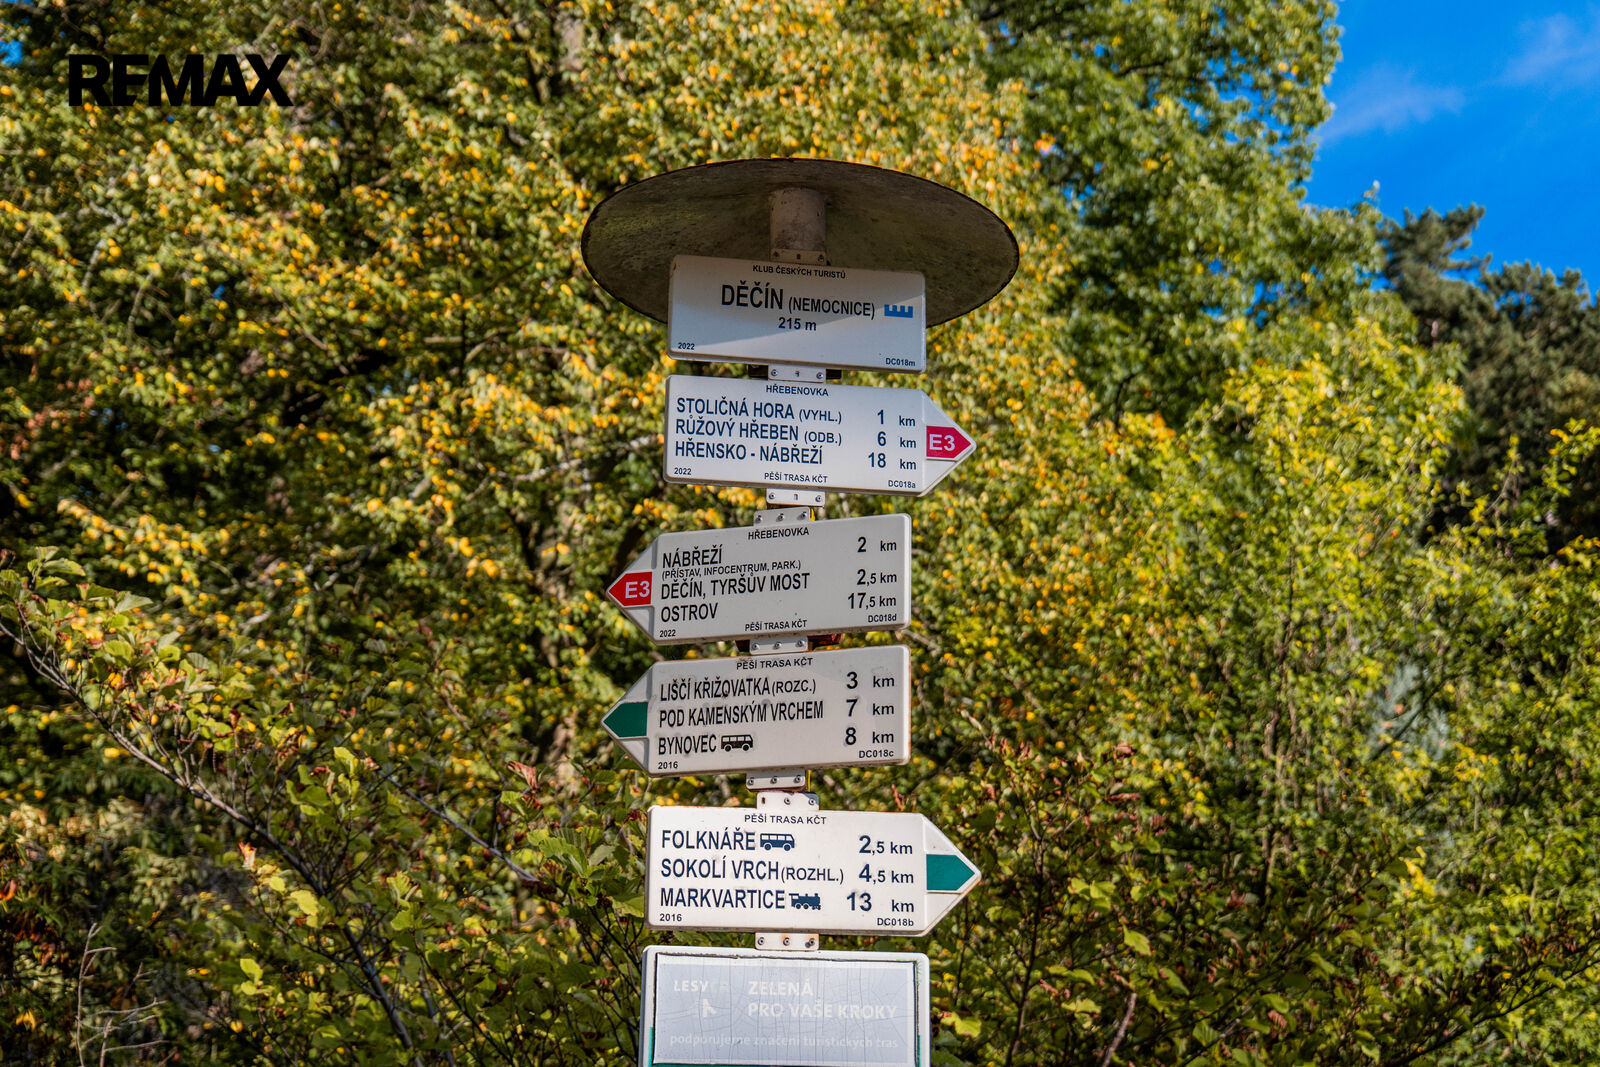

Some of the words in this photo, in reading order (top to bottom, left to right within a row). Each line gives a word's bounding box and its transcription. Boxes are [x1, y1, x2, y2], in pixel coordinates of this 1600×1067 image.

[753, 265, 773, 274] KLUB
[776, 266, 811, 276] ČESKÝCH
[814, 269, 846, 279] TURISTŮ
[722, 280, 783, 310] DĚČÍN
[789, 296, 875, 320] (NEMOCNICE)
[778, 317, 801, 330] 215
[805, 320, 817, 331] m
[678, 342, 695, 350] 2022
[886, 358, 916, 366] DC018m
[766, 384, 828, 397] HŘEBENOVKA
[676, 396, 749, 417] STOLIČNÁ
[753, 402, 795, 419] HORA
[799, 409, 842, 424] (VYHL.)
[877, 409, 884, 424] 1
[899, 415, 916, 427] km
[676, 414, 735, 436] RŮŽOVÝ
[740, 421, 799, 441] HŘEBEN
[804, 431, 842, 445] (ODB.)
[877, 432, 886, 446] 6
[899, 437, 917, 449] km
[929, 434, 955, 451] E3
[675, 438, 746, 460] HŘENSKO
[760, 445, 823, 465] NÁBŘEŽÍ
[868, 452, 886, 469] 18
[900, 459, 917, 470] km
[674, 467, 692, 476] 2022
[764, 472, 782, 481] PĚŠÍ
[784, 474, 810, 482] TRASA
[811, 474, 827, 483] KČT
[888, 479, 916, 489] DC018a
[748, 526, 809, 540] HŘEBENOVKA
[662, 544, 722, 568] NÁBŘEŽÍ
[858, 536, 866, 552] 2
[880, 540, 896, 552] km
[662, 567, 702, 580] (PŘÍSTAV,
[704, 562, 769, 576] INFOCENTRUM,
[772, 560, 801, 571] PARK.)
[625, 580, 650, 598] E3
[661, 578, 706, 600] DĚČÍN,
[711, 572, 766, 596] TYRŠŮV
[770, 573, 810, 591] MOST
[857, 569, 876, 586] 2,5
[880, 573, 897, 584] km
[661, 602, 718, 622] OSTROV
[848, 592, 876, 610] 17,5
[879, 596, 896, 607] km
[745, 622, 762, 631] PĚŠÍ
[764, 621, 789, 630] TRASA
[791, 618, 807, 628] KČT
[868, 614, 897, 623] DC018d
[660, 629, 676, 638] 2022
[736, 659, 758, 670] PĚŠÍ
[760, 659, 792, 668] TRASA
[794, 656, 813, 666] KČT
[660, 680, 691, 702] LIŠČÍ
[846, 671, 858, 689] 3
[872, 675, 895, 688] km
[659, 708, 684, 728] POD
[688, 700, 767, 726] KAMENSKÝM
[771, 700, 823, 720] VRCHEM
[846, 698, 858, 717] 7
[872, 703, 895, 716] km
[658, 734, 717, 756] BYNOVEC
[845, 726, 857, 745] 8
[872, 731, 894, 744] km
[859, 750, 894, 758] DC018c
[658, 761, 678, 770] 2016
[744, 813, 767, 823] PĚŠÍ
[770, 815, 803, 824] TRASA
[806, 815, 826, 825] KČT
[661, 827, 756, 851] FOLKNÁŘE
[859, 835, 885, 855] 2,5
[890, 841, 913, 854] km
[661, 856, 727, 879] SOKOLÍ
[859, 864, 886, 884] 4,5
[891, 870, 914, 883] km
[660, 887, 785, 909] MARKVARTICE
[847, 892, 872, 912] 13
[891, 899, 914, 913] km
[660, 913, 682, 922] 2016
[877, 918, 914, 927] DC018b
[748, 979, 814, 997] ZELENÁ
[748, 1002, 784, 1017] PRO
[789, 999, 833, 1018] VAŠE
[837, 1003, 897, 1019] KROKY
[670, 1034, 750, 1047] podporujeme
